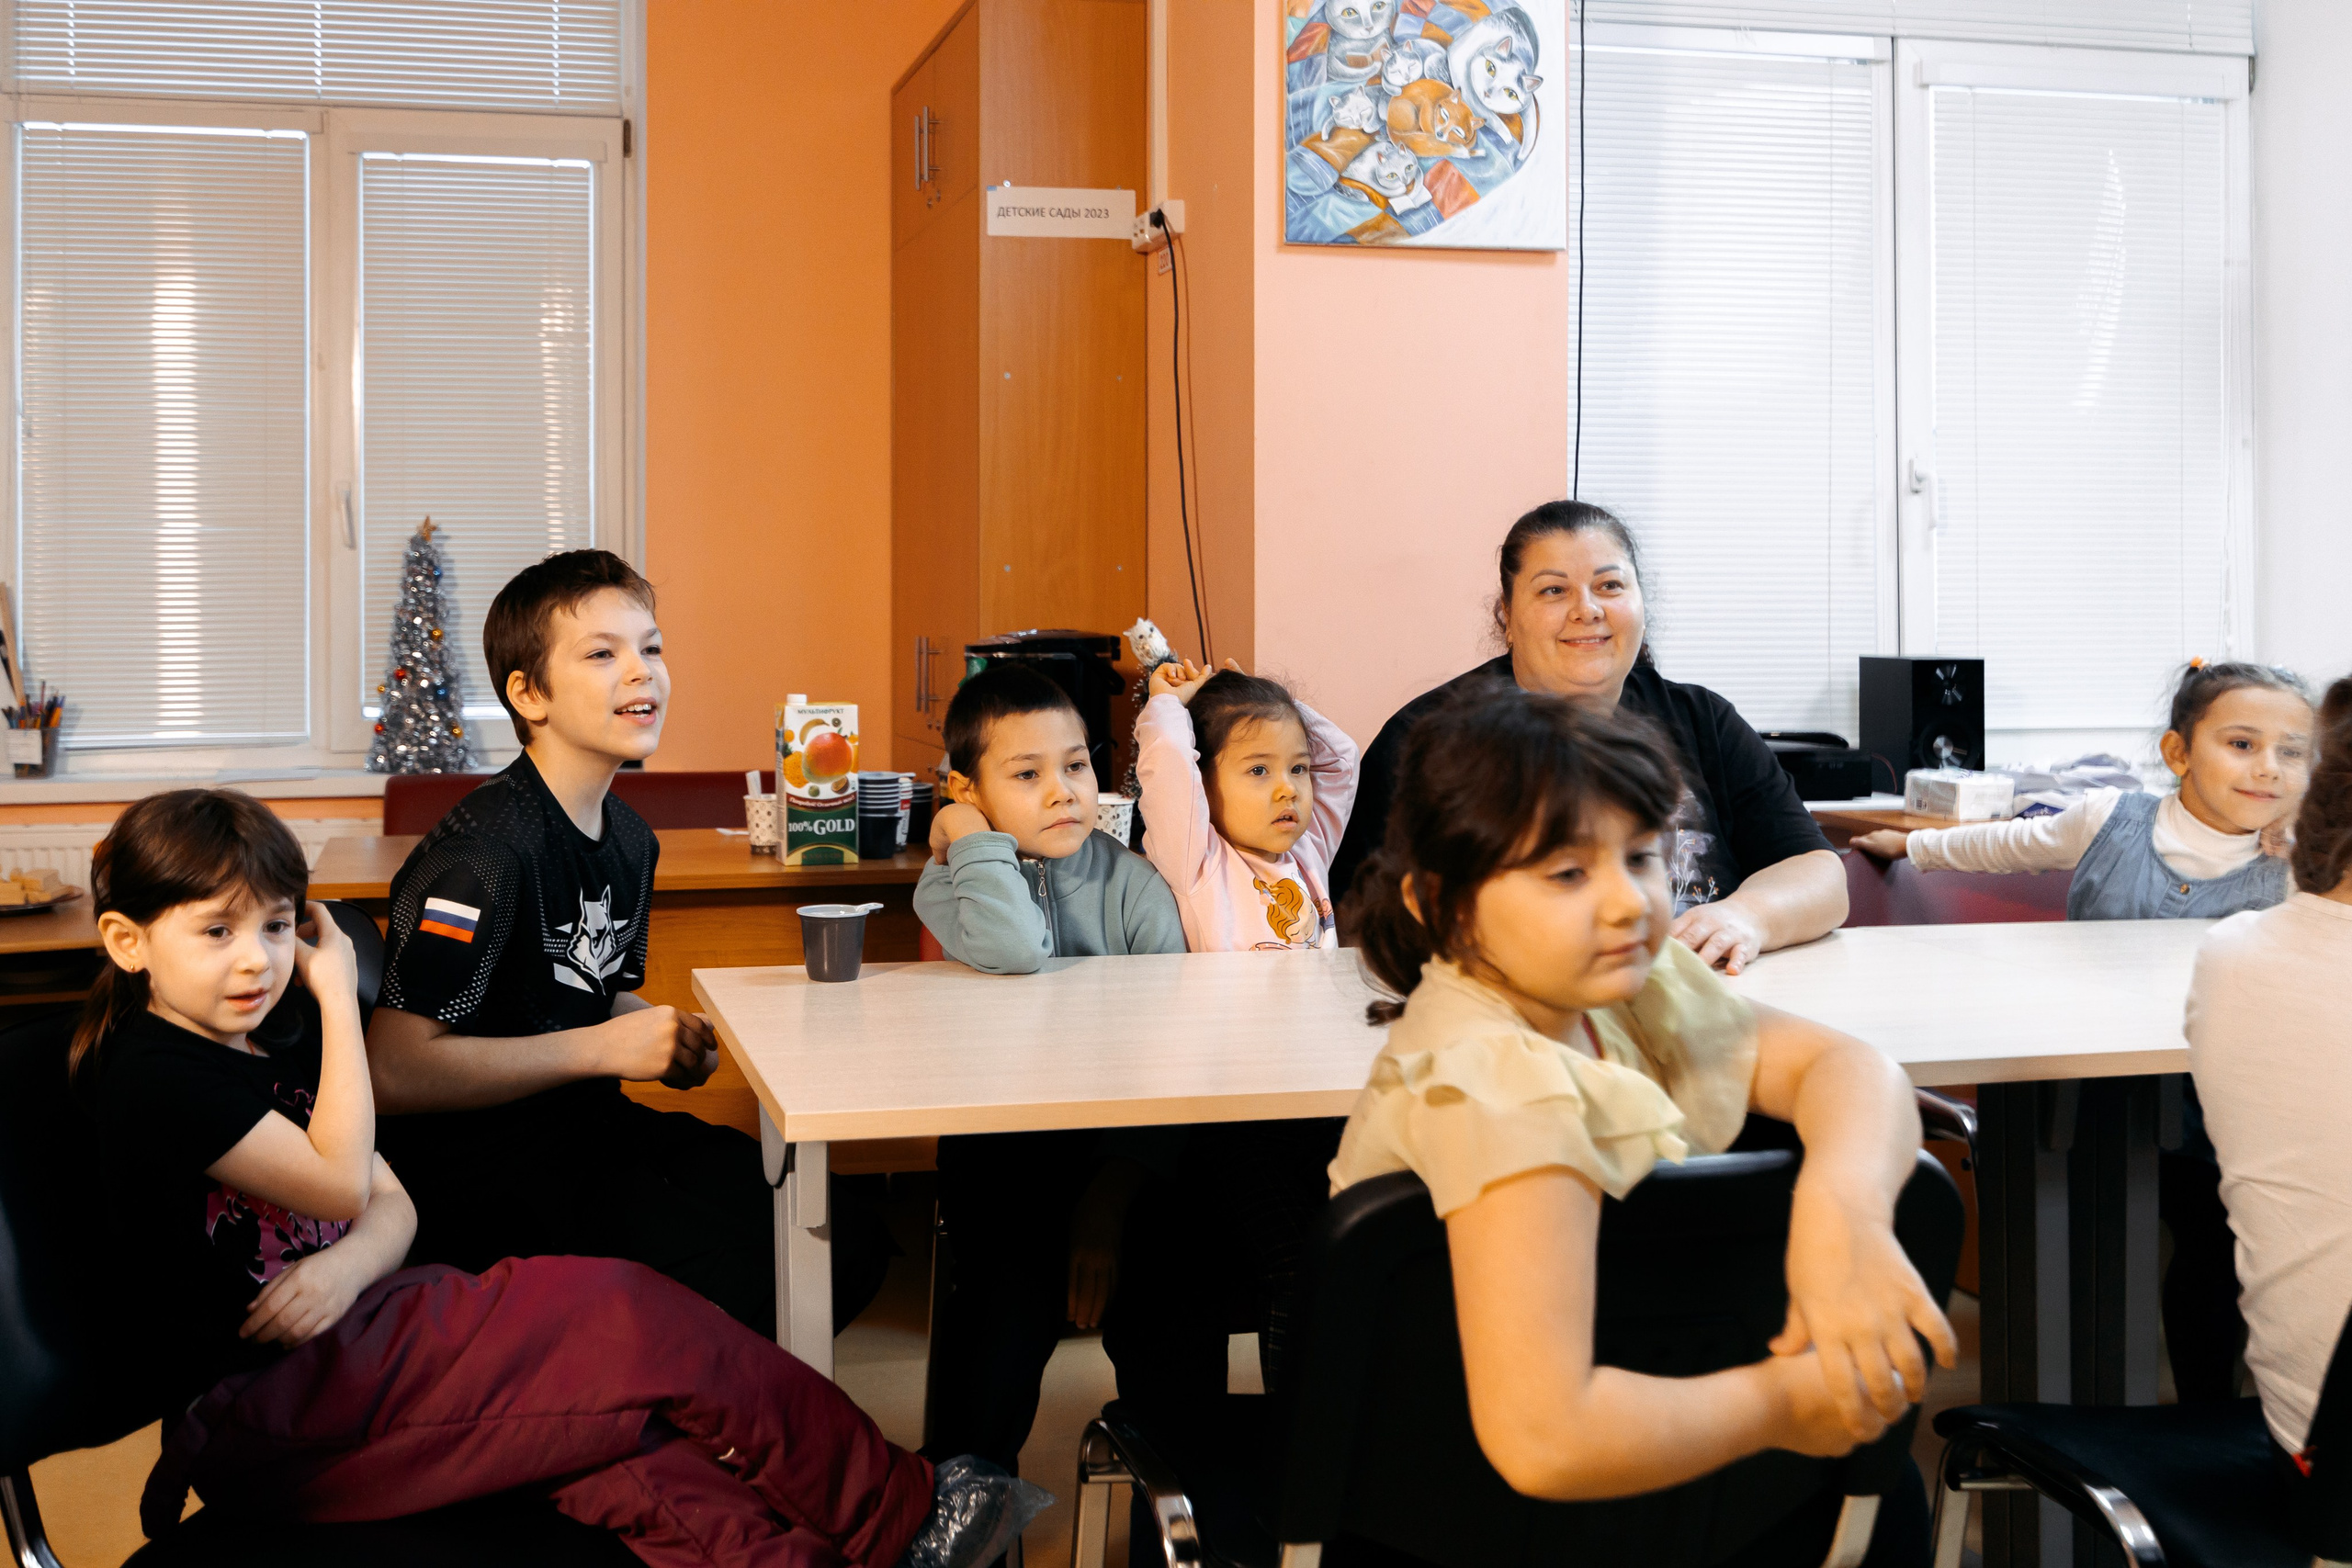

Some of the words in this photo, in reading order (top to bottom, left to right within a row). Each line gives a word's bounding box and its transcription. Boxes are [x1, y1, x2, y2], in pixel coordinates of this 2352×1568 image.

[997, 207, 1046, 219] ДЕТСКИЕ
[1048, 208, 1081, 220] САДЫ
[1084, 208, 1110, 219] 2023
[813, 818, 855, 835] GOLD
